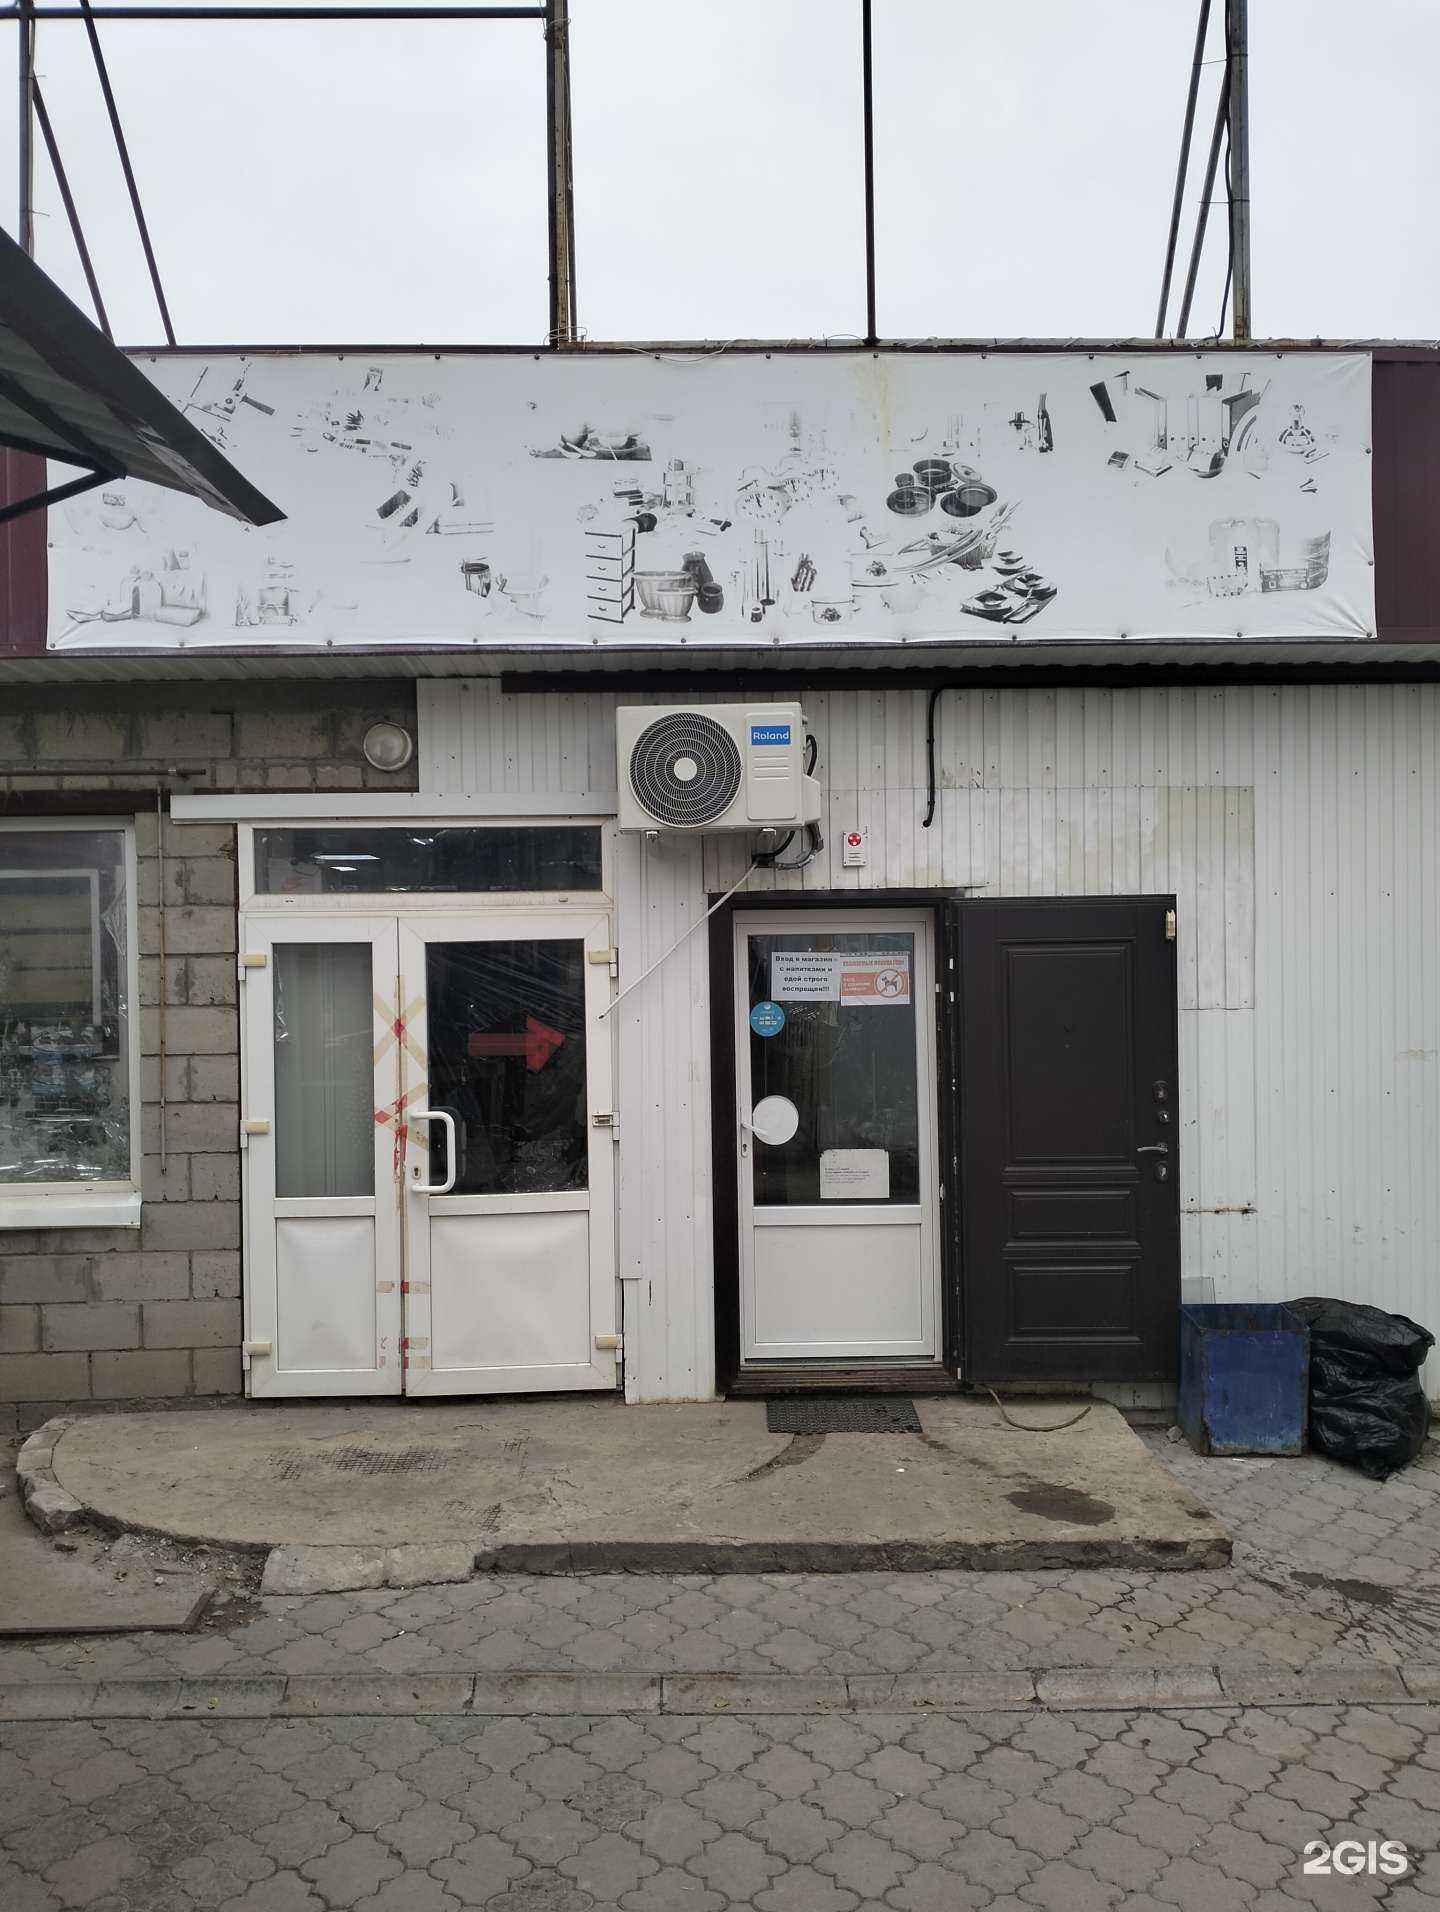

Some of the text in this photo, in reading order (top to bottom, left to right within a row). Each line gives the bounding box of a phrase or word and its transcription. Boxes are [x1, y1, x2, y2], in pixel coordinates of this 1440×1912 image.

[753, 730, 790, 740] Roland
[775, 955, 794, 963] Вход
[784, 975, 802, 983] едой
